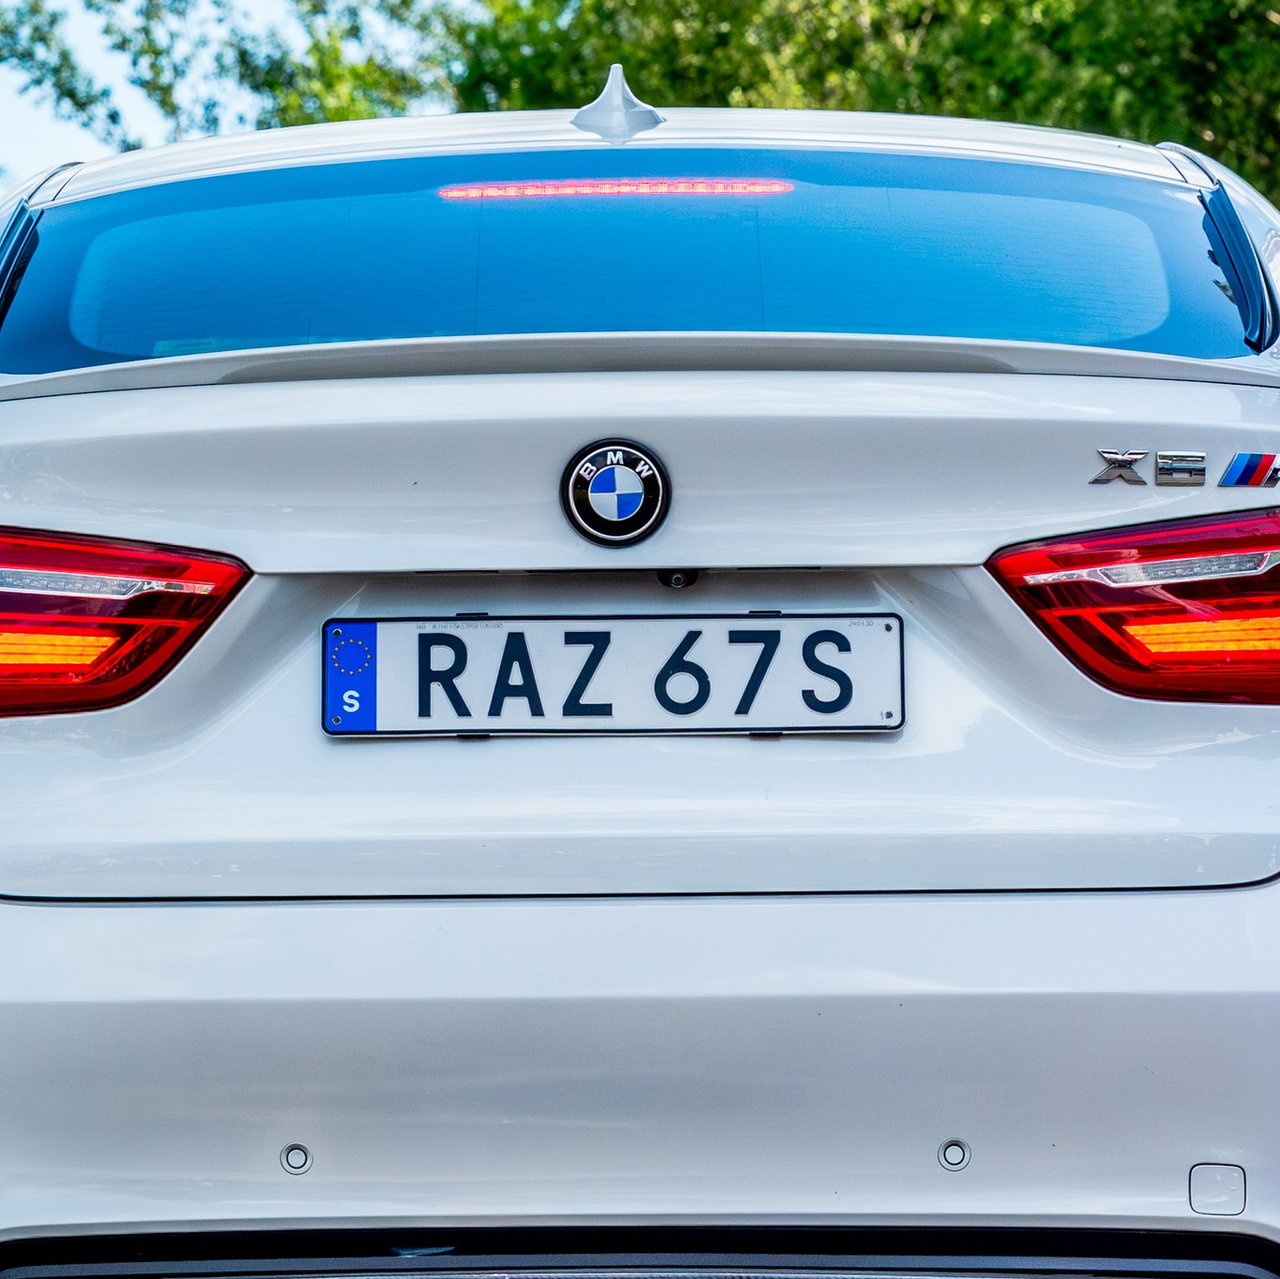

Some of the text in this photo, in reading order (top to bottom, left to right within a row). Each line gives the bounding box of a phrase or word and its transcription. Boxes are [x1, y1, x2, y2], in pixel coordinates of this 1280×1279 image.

[579, 450, 654, 481] BMW
[1088, 448, 1208, 487] X6
[417, 629, 854, 718] RAZ 67S
[342, 689, 360, 713] S
